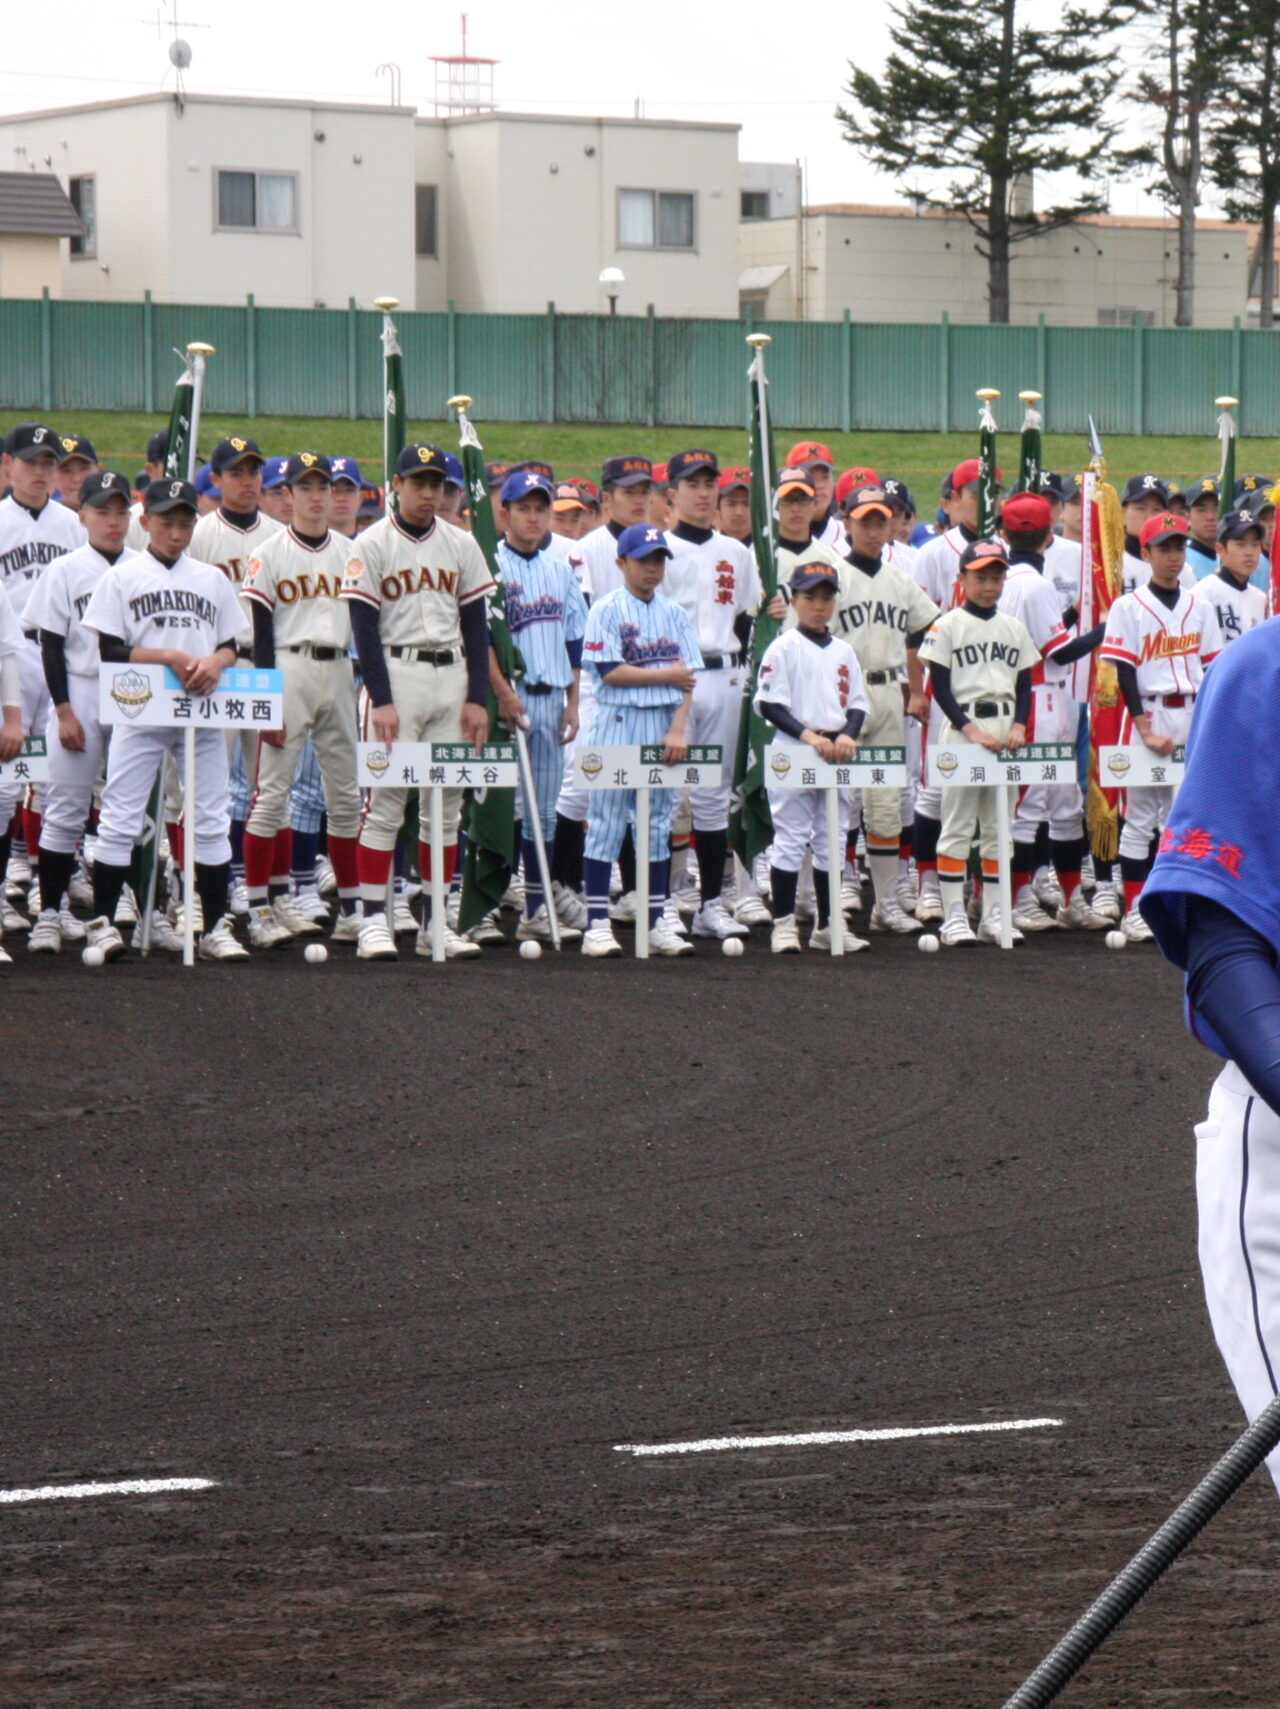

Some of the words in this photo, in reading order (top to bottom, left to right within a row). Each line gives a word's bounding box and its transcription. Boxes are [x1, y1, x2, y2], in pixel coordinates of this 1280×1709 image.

[129, 590, 217, 629] TOMAKOMAI
[952, 641, 1020, 668] TOYAKO
[172, 697, 272, 720] 苫小牧西
[403, 766, 499, 784] 札幌大谷
[613, 767, 700, 785] 北広島
[801, 768, 886, 785] 函館東
[970, 764, 1057, 783] 洞爺湖
